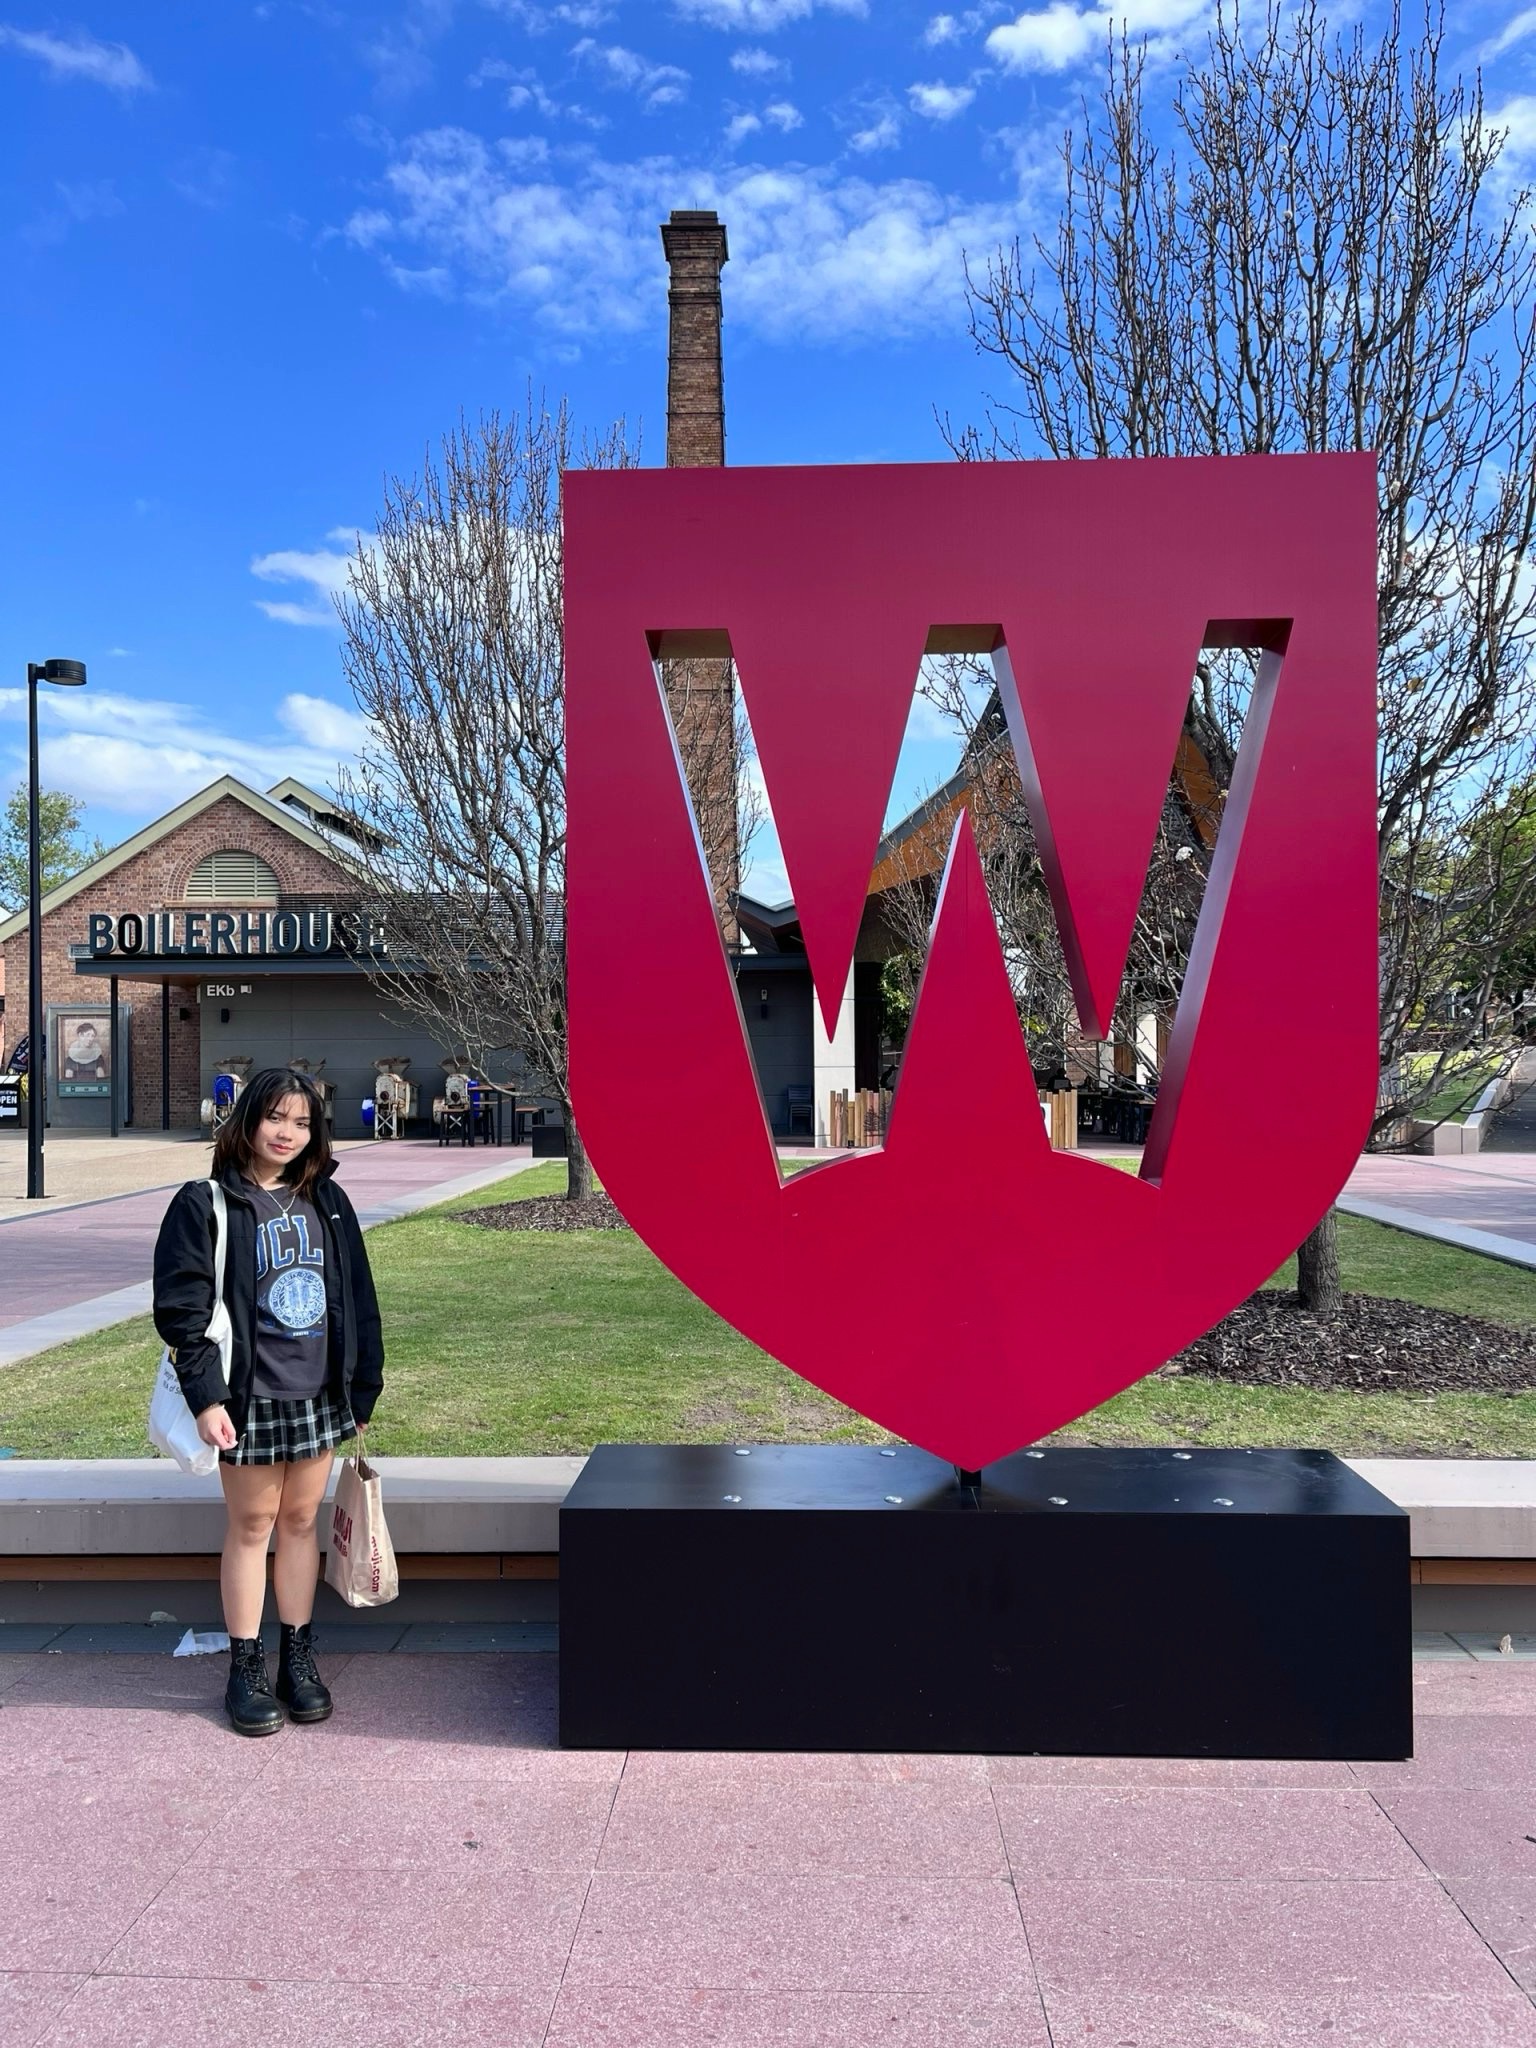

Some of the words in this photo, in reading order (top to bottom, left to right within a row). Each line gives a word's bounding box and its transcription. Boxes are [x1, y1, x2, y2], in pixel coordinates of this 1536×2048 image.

[89, 912, 387, 954] BOILERHOUSE
[207, 985, 235, 996] EKb
[0, 1096, 17, 1104] PEN
[371, 1536, 382, 1592] muji.com
